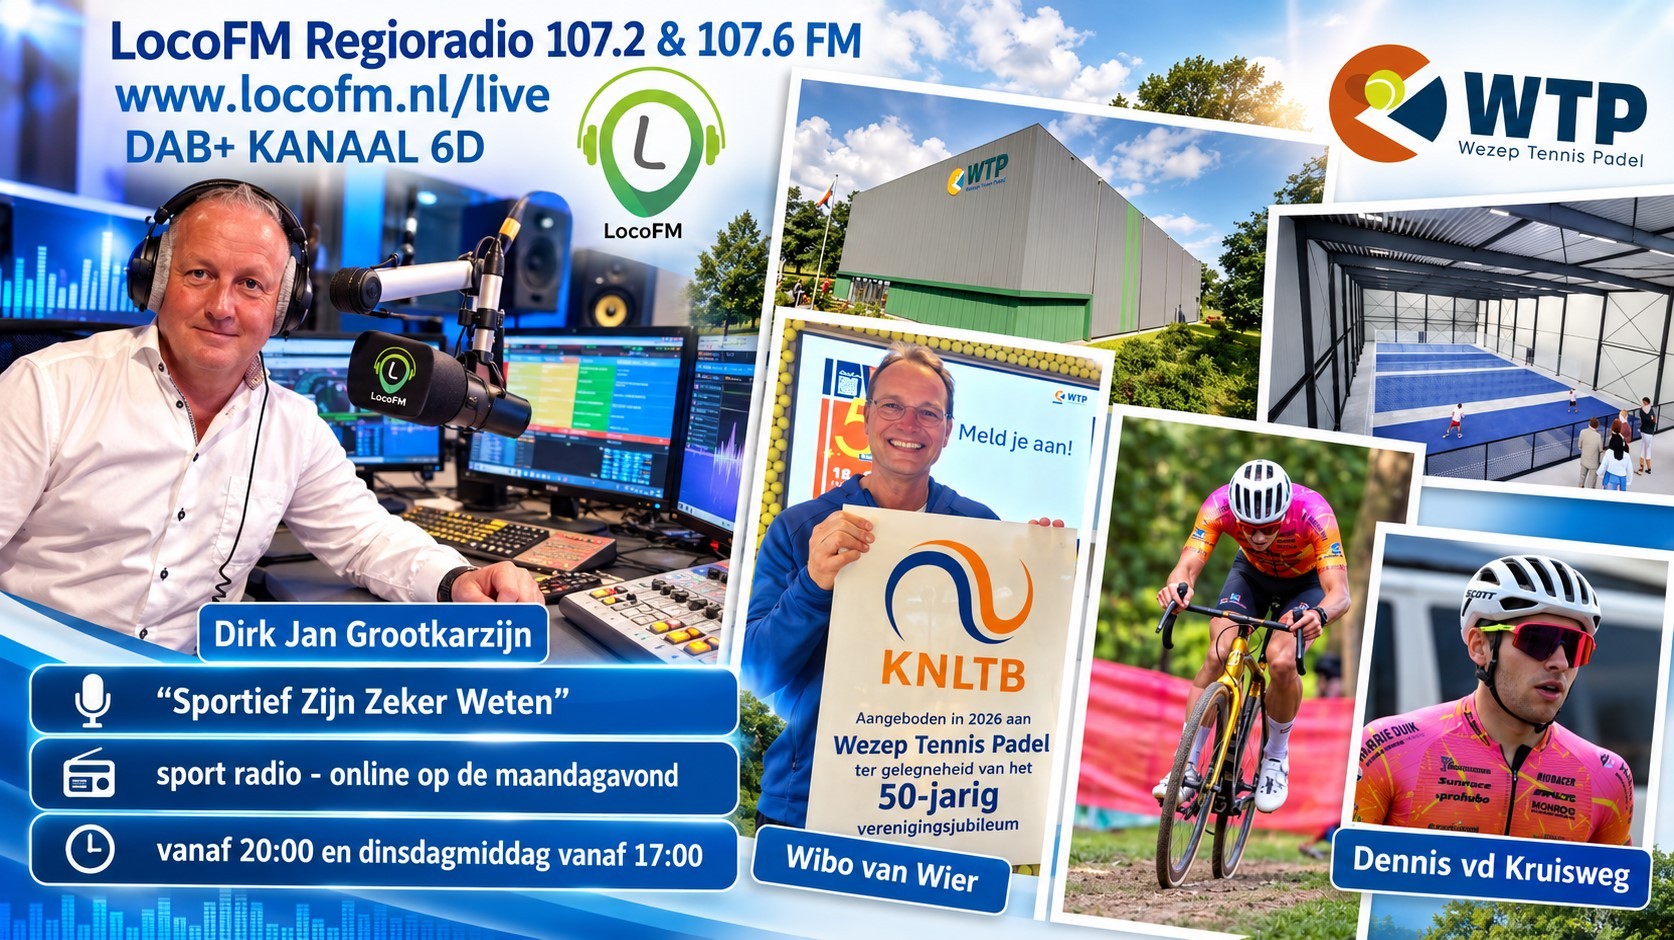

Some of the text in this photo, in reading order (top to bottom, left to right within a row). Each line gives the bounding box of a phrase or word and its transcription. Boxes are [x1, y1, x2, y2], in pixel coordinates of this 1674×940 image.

[967, 153, 1009, 186] WTP
[370, 391, 407, 407] LocoFM
[1066, 392, 1088, 403] WTP
[958, 423, 1073, 456] Meld je aan!
[1465, 589, 1498, 600] SCOTT
[881, 649, 1026, 693] KNLTB
[855, 711, 1032, 728] Aangeboden in 2026 aan
[833, 733, 1050, 760] Wezep Tennis Padel
[855, 761, 1033, 780] ter gelegneheid van het
[878, 780, 999, 816] 50-jarig
[857, 817, 1020, 838] verenigingsjubileum
